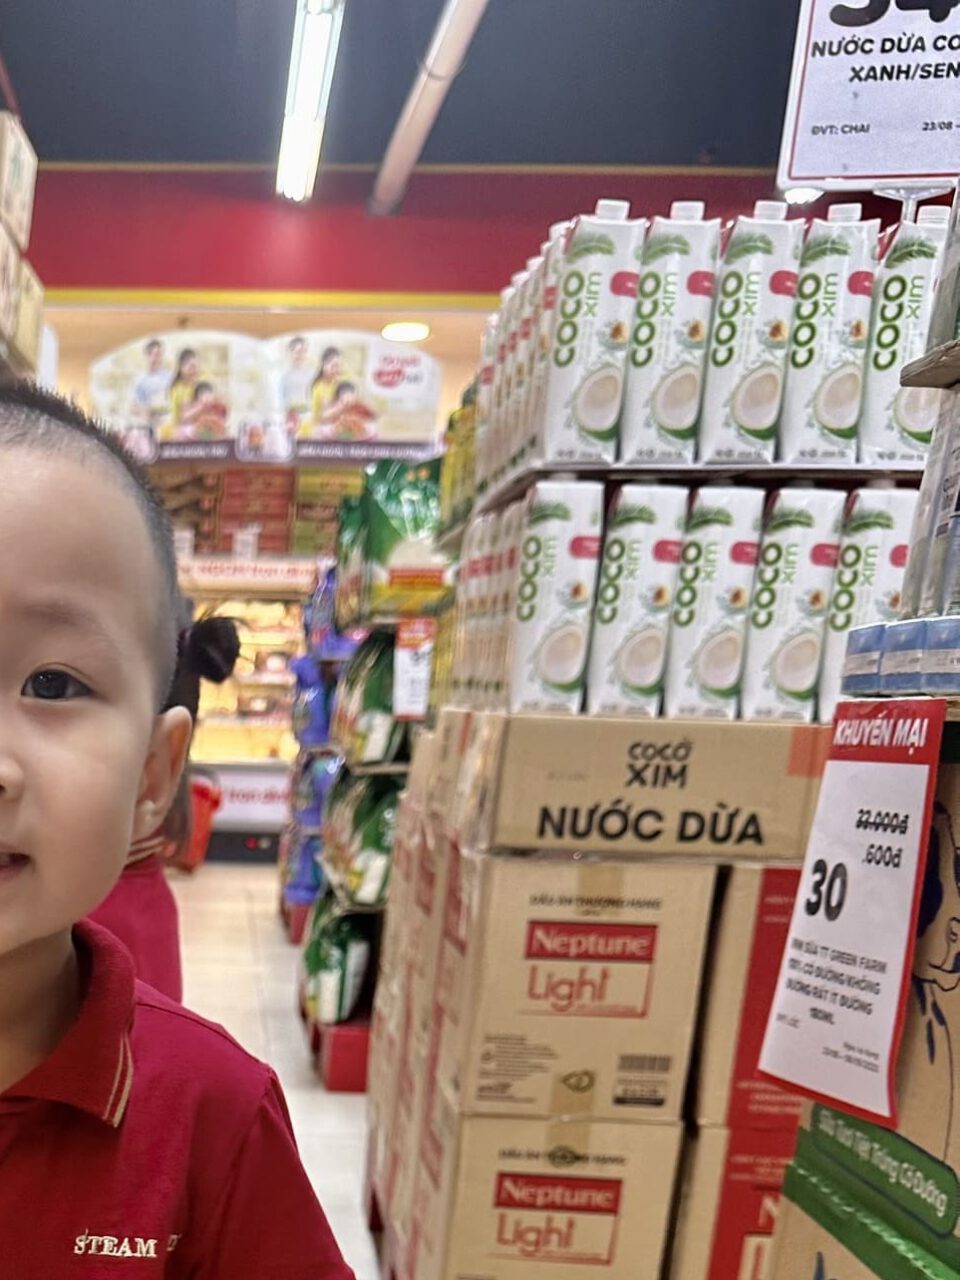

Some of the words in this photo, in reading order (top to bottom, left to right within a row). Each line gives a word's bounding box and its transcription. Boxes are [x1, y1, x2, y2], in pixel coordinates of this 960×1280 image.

[811, 34, 875, 58] NƯỚC
[880, 32, 926, 54] DỪA
[840, 124, 871, 134] CHAI
[833, 710, 889, 746] KHUYẾN
[893, 717, 929, 755] MẠI
[625, 763, 688, 789] XIM
[537, 799, 664, 842] NƯỚC
[677, 802, 765, 846] DỪA
[805, 859, 847, 921] 30
[532, 928, 649, 957] Neptune
[528, 964, 610, 1012] Light
[500, 1178, 615, 1206] Neptune
[74, 1233, 157, 1257] STEAM
[497, 1212, 575, 1257] Light
